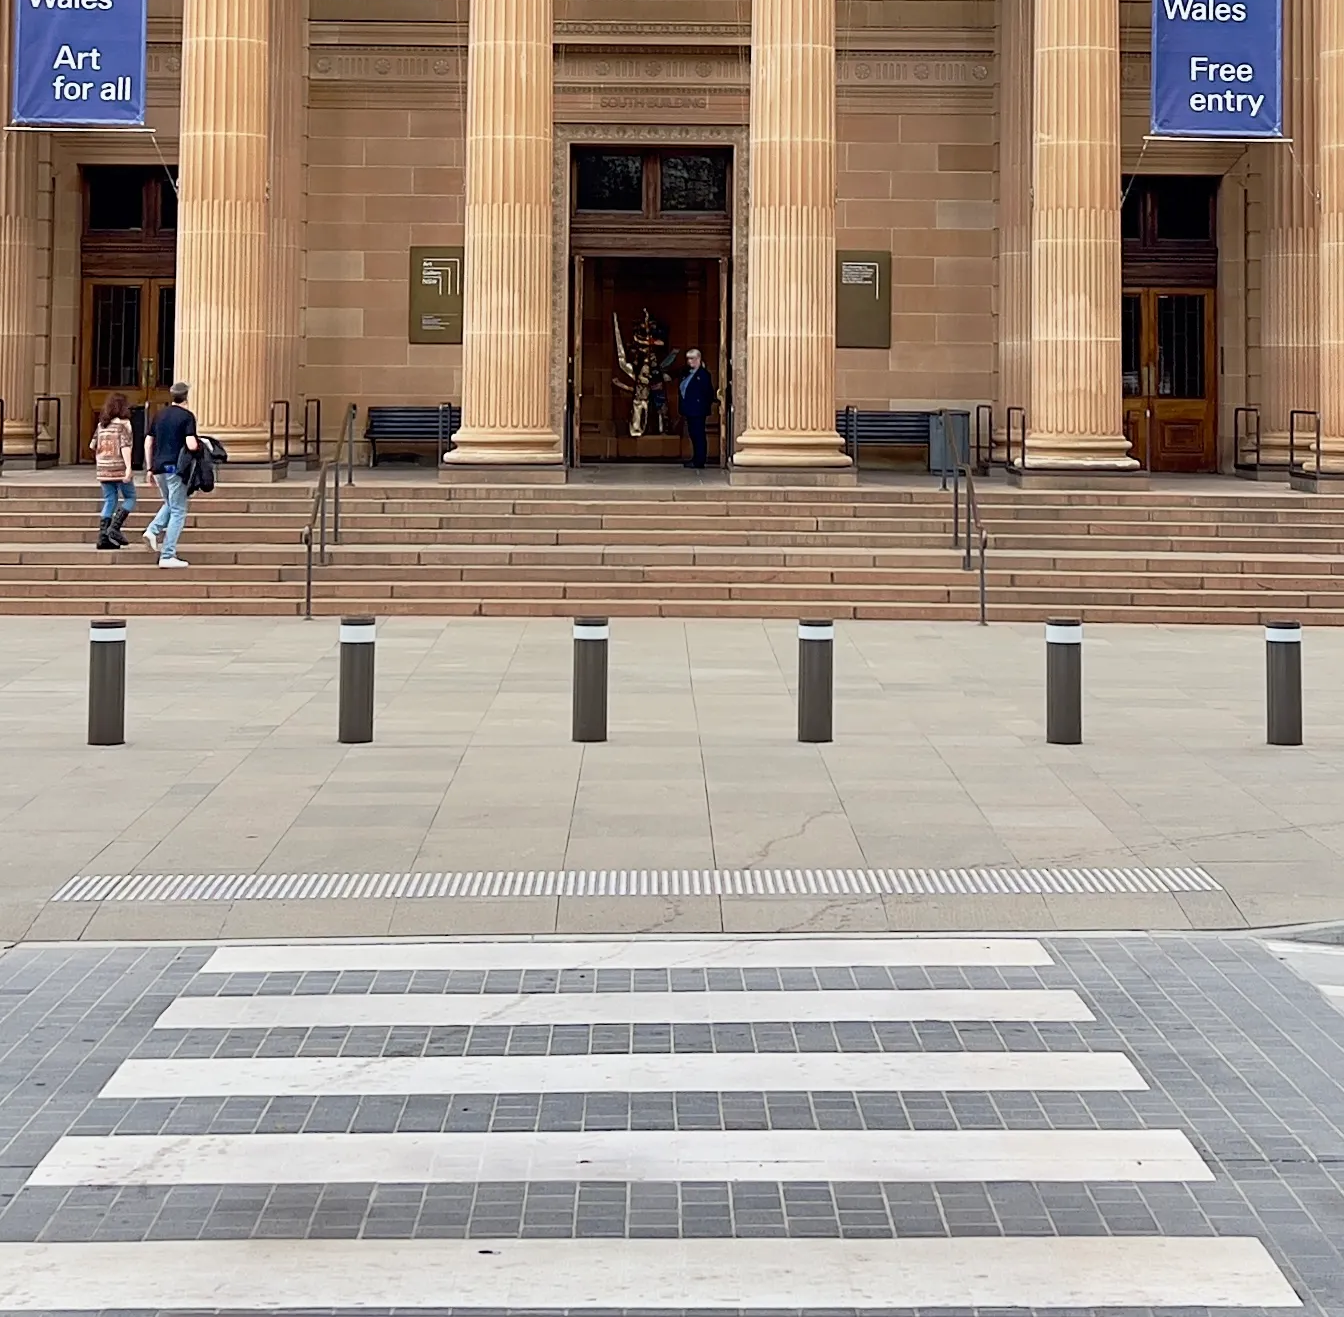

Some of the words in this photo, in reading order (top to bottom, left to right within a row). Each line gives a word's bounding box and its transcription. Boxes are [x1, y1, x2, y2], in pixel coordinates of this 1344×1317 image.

[53, 45, 101, 70] Art
[1190, 56, 1253, 82] Free
[52, 75, 94, 101] for
[100, 76, 131, 101] all
[599, 96, 644, 109] SOUTH
[1189, 89, 1265, 117] entry
